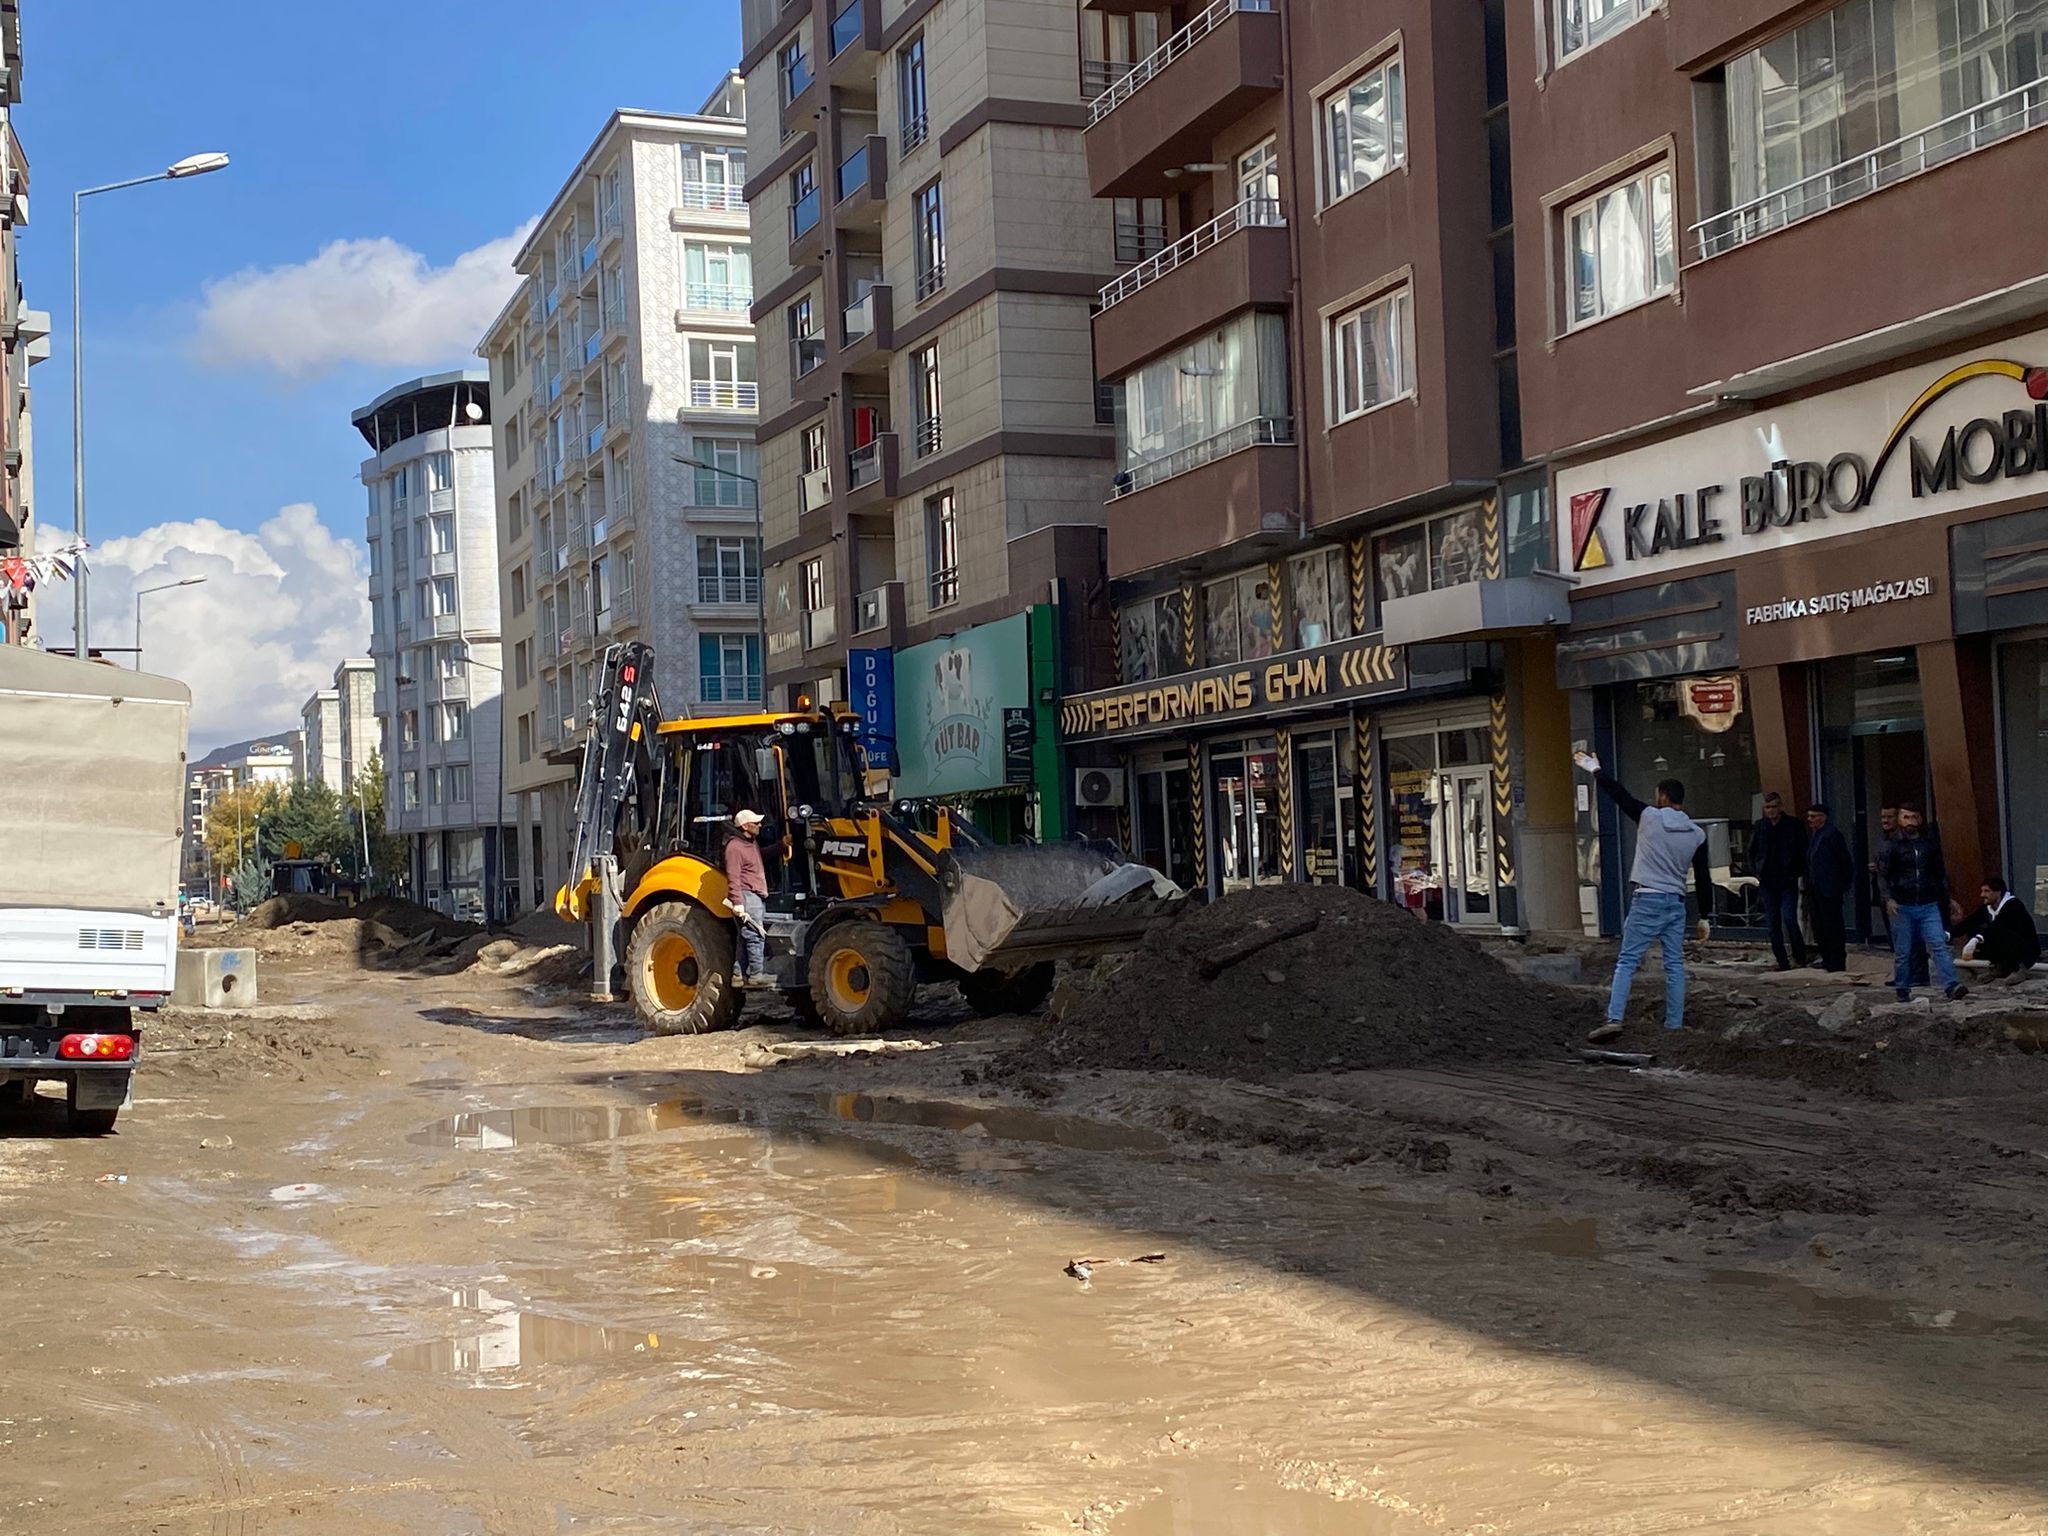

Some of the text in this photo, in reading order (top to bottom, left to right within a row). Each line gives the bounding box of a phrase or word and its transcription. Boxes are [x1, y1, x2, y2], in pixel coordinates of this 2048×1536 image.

[1624, 484, 1726, 562] KALE
[1740, 452, 1870, 536] BÜRO
[1746, 576, 1932, 625] FABRİKA SATIŞ MAĞAZASI
[1091, 655, 1328, 731] PERFORMANS GYM
[861, 750, 888, 762] ÜFE
[957, 721, 980, 757] BAR
[821, 840, 866, 857] MST
